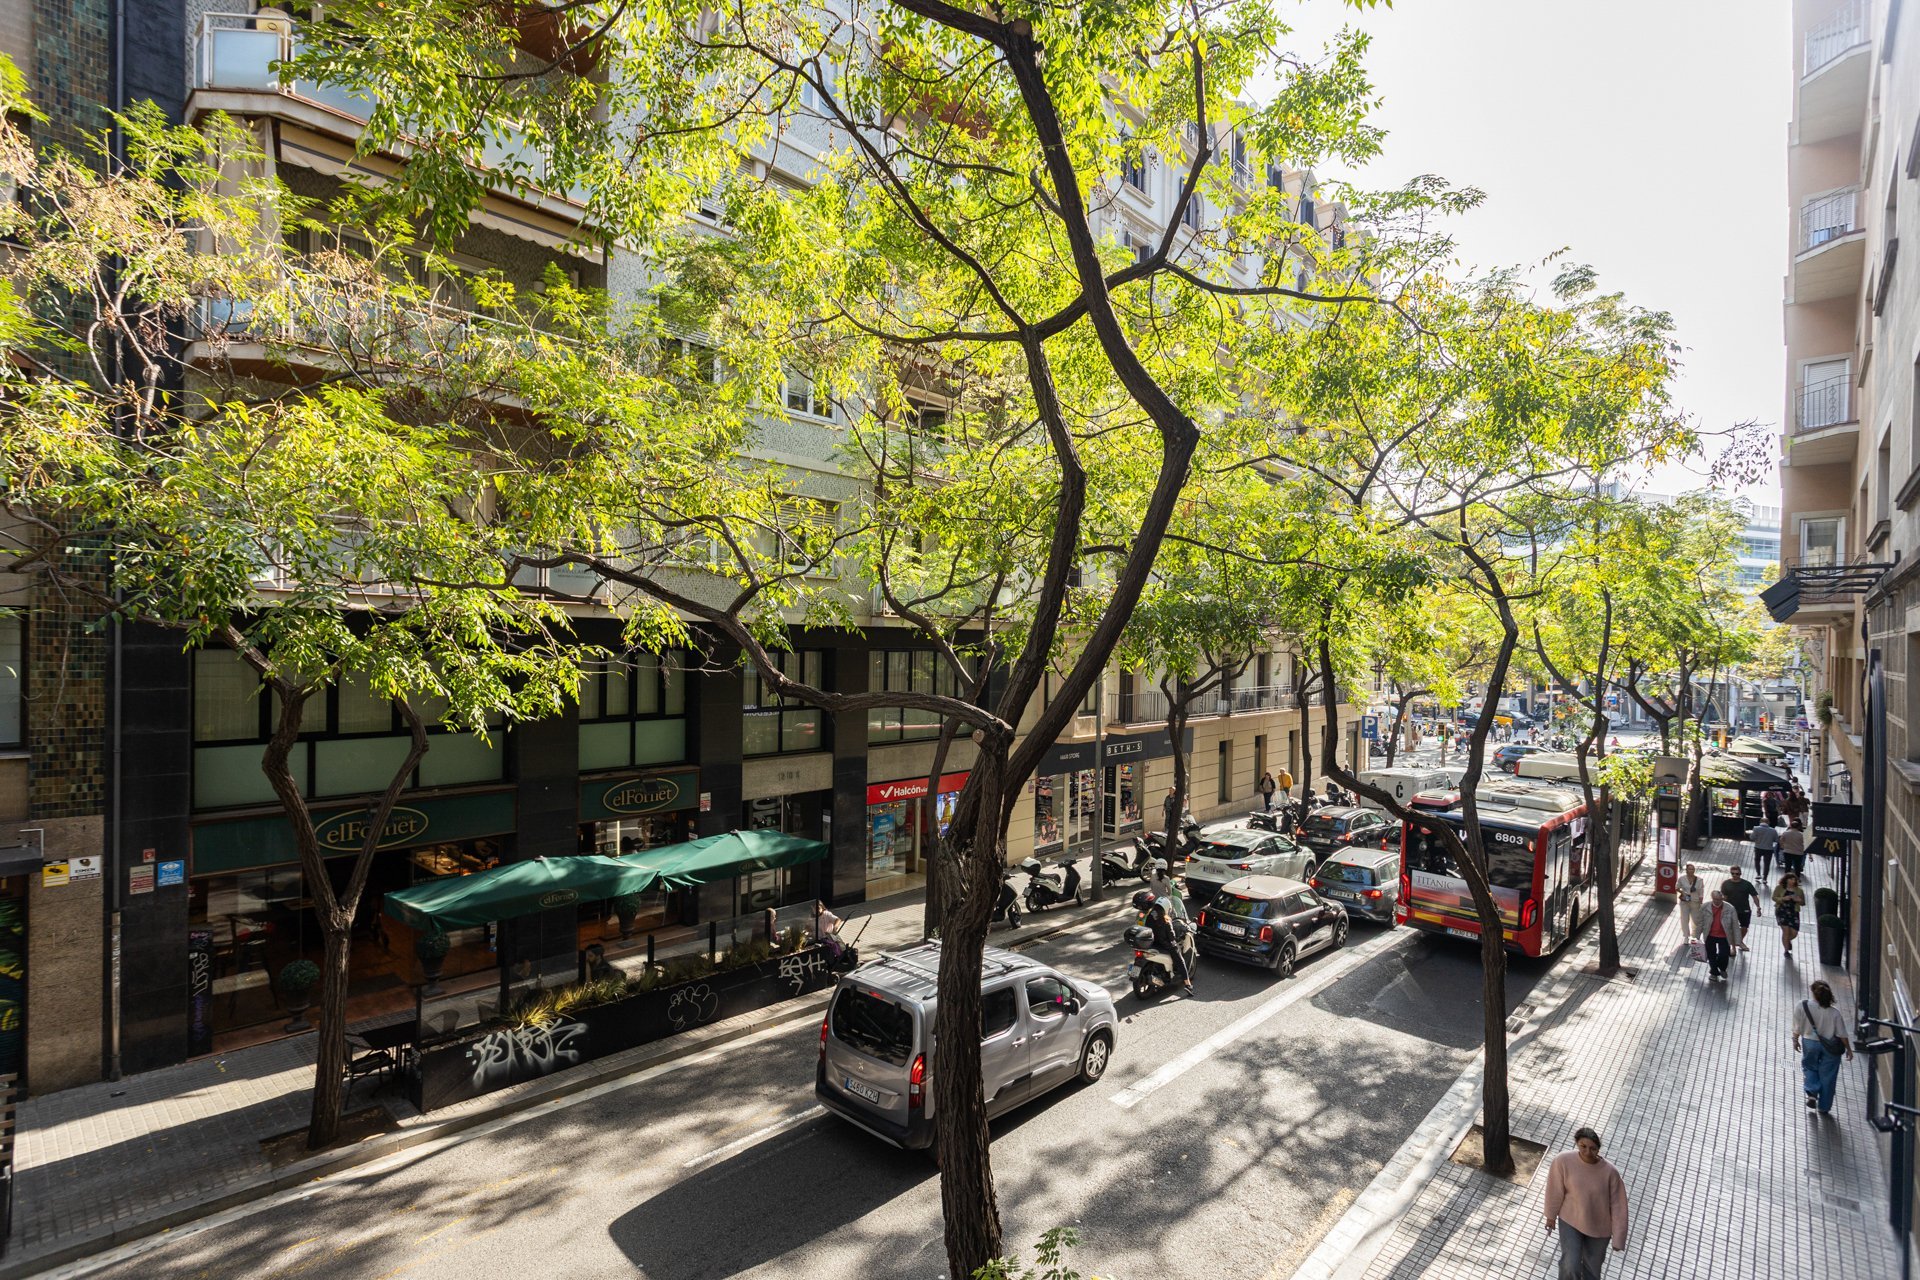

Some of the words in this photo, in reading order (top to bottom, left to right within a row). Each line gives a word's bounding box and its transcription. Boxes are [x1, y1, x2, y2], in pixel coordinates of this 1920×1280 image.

[1364, 716, 1376, 730] P
[893, 785, 920, 797] Halcón
[1814, 825, 1861, 835] CALZEDONIA
[1495, 832, 1524, 845] 6803
[1415, 875, 1455, 891] TITANIC
[864, 1087, 878, 1101] KZH
